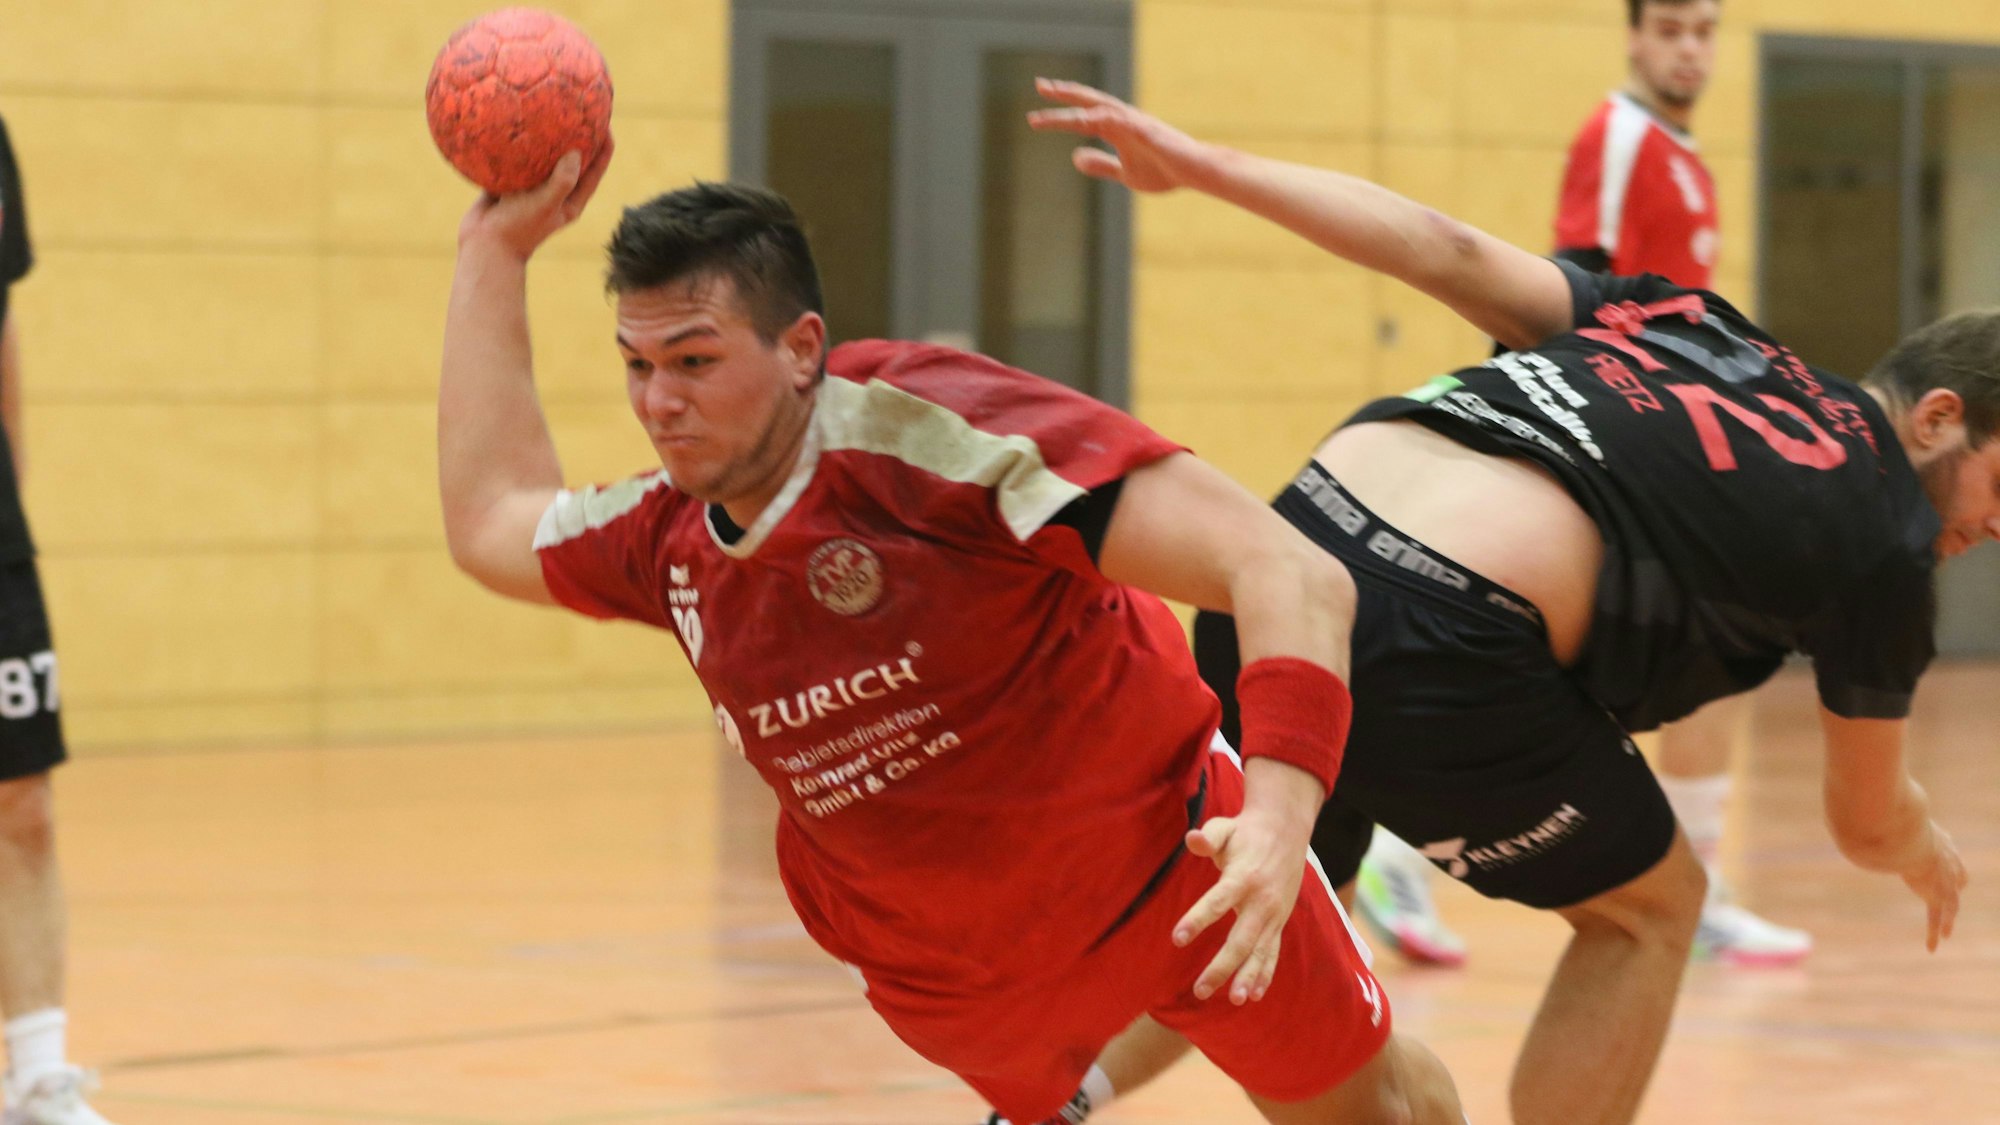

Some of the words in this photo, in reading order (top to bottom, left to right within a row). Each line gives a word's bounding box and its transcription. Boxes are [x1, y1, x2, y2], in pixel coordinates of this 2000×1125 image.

[0, 651, 57, 718] 87
[748, 657, 922, 738] ZURICH
[864, 774, 886, 794] &
